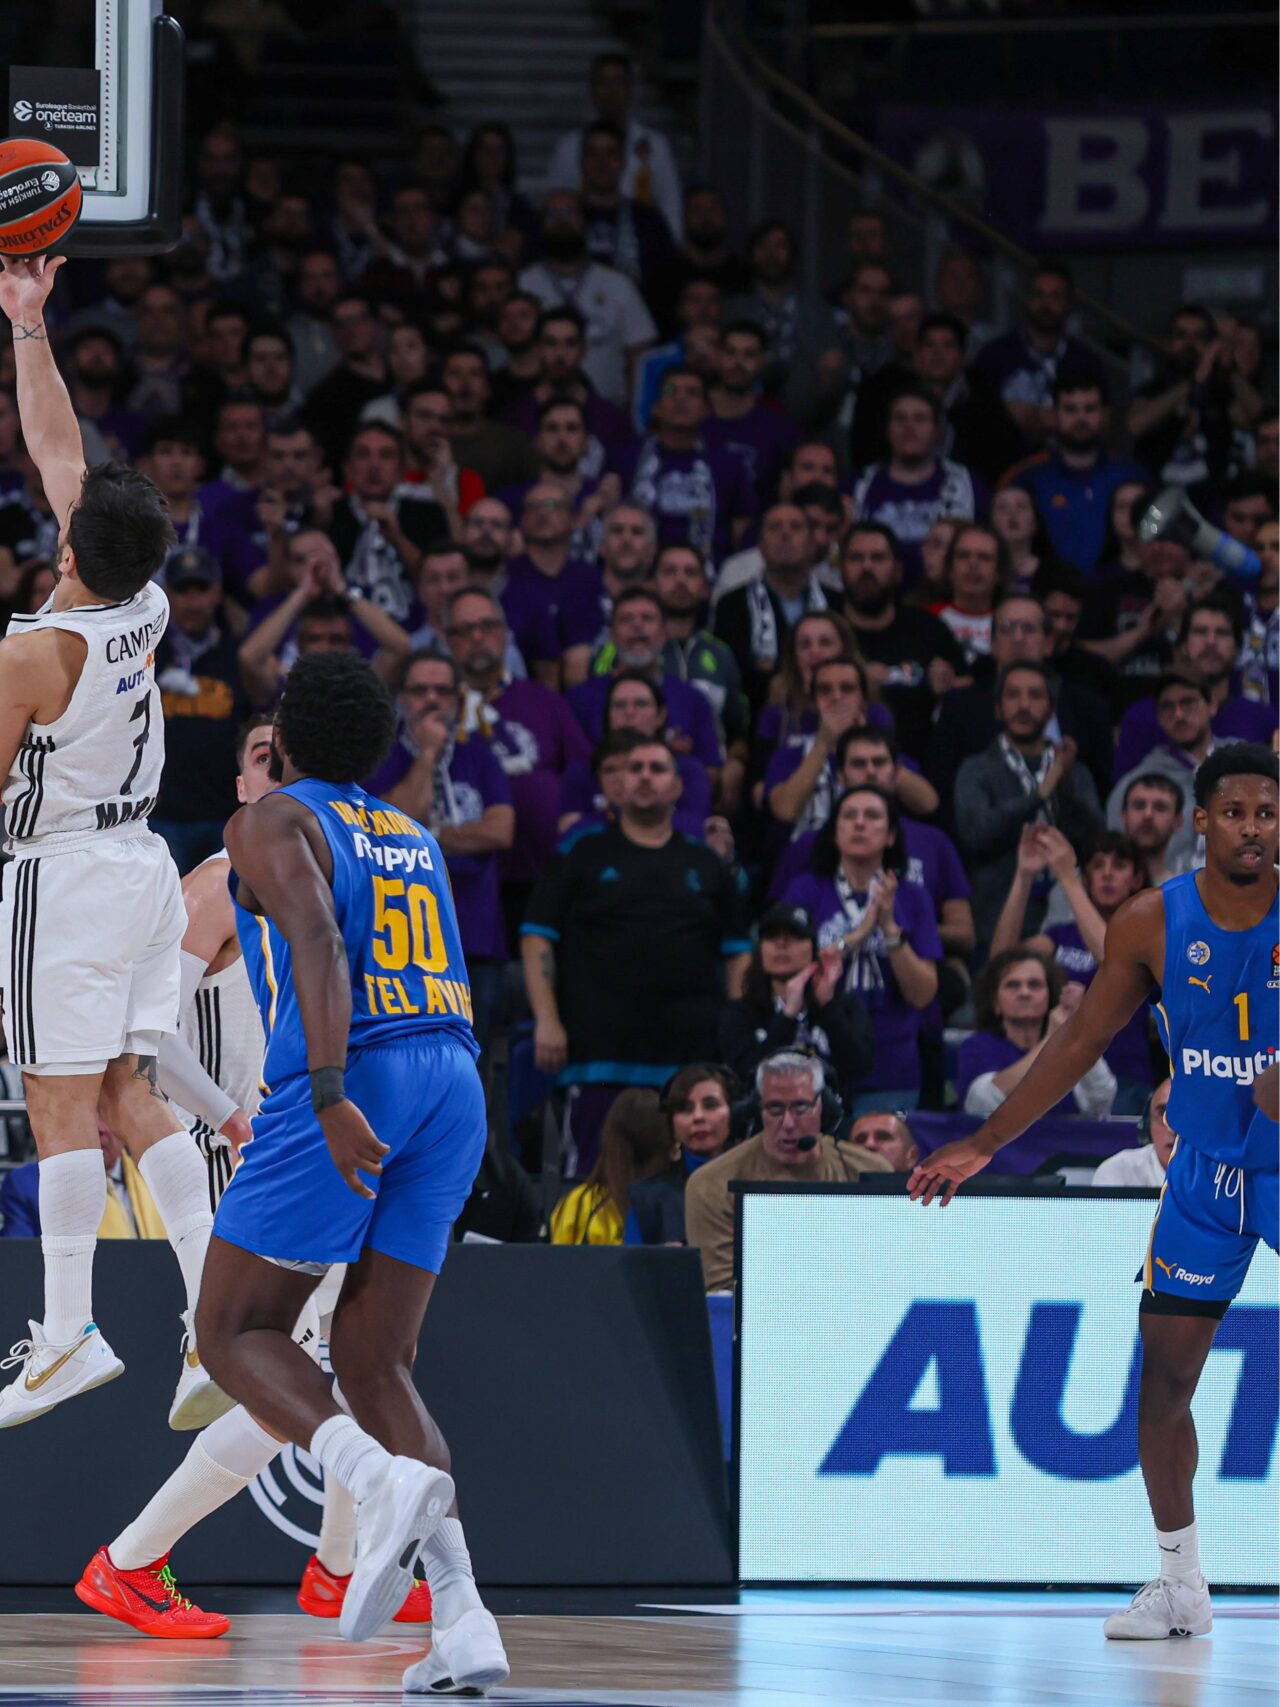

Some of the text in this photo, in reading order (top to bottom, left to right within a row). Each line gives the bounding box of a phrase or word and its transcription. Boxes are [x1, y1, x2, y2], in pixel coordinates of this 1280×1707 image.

[35, 110, 97, 123] oneteam
[9, 187, 42, 206] TURKISH
[120, 689, 151, 796] 7
[372, 875, 449, 973] 50
[364, 973, 420, 1015] TEL
[1233, 992, 1250, 1041] 1
[1174, 1268, 1216, 1286] Rapyd
